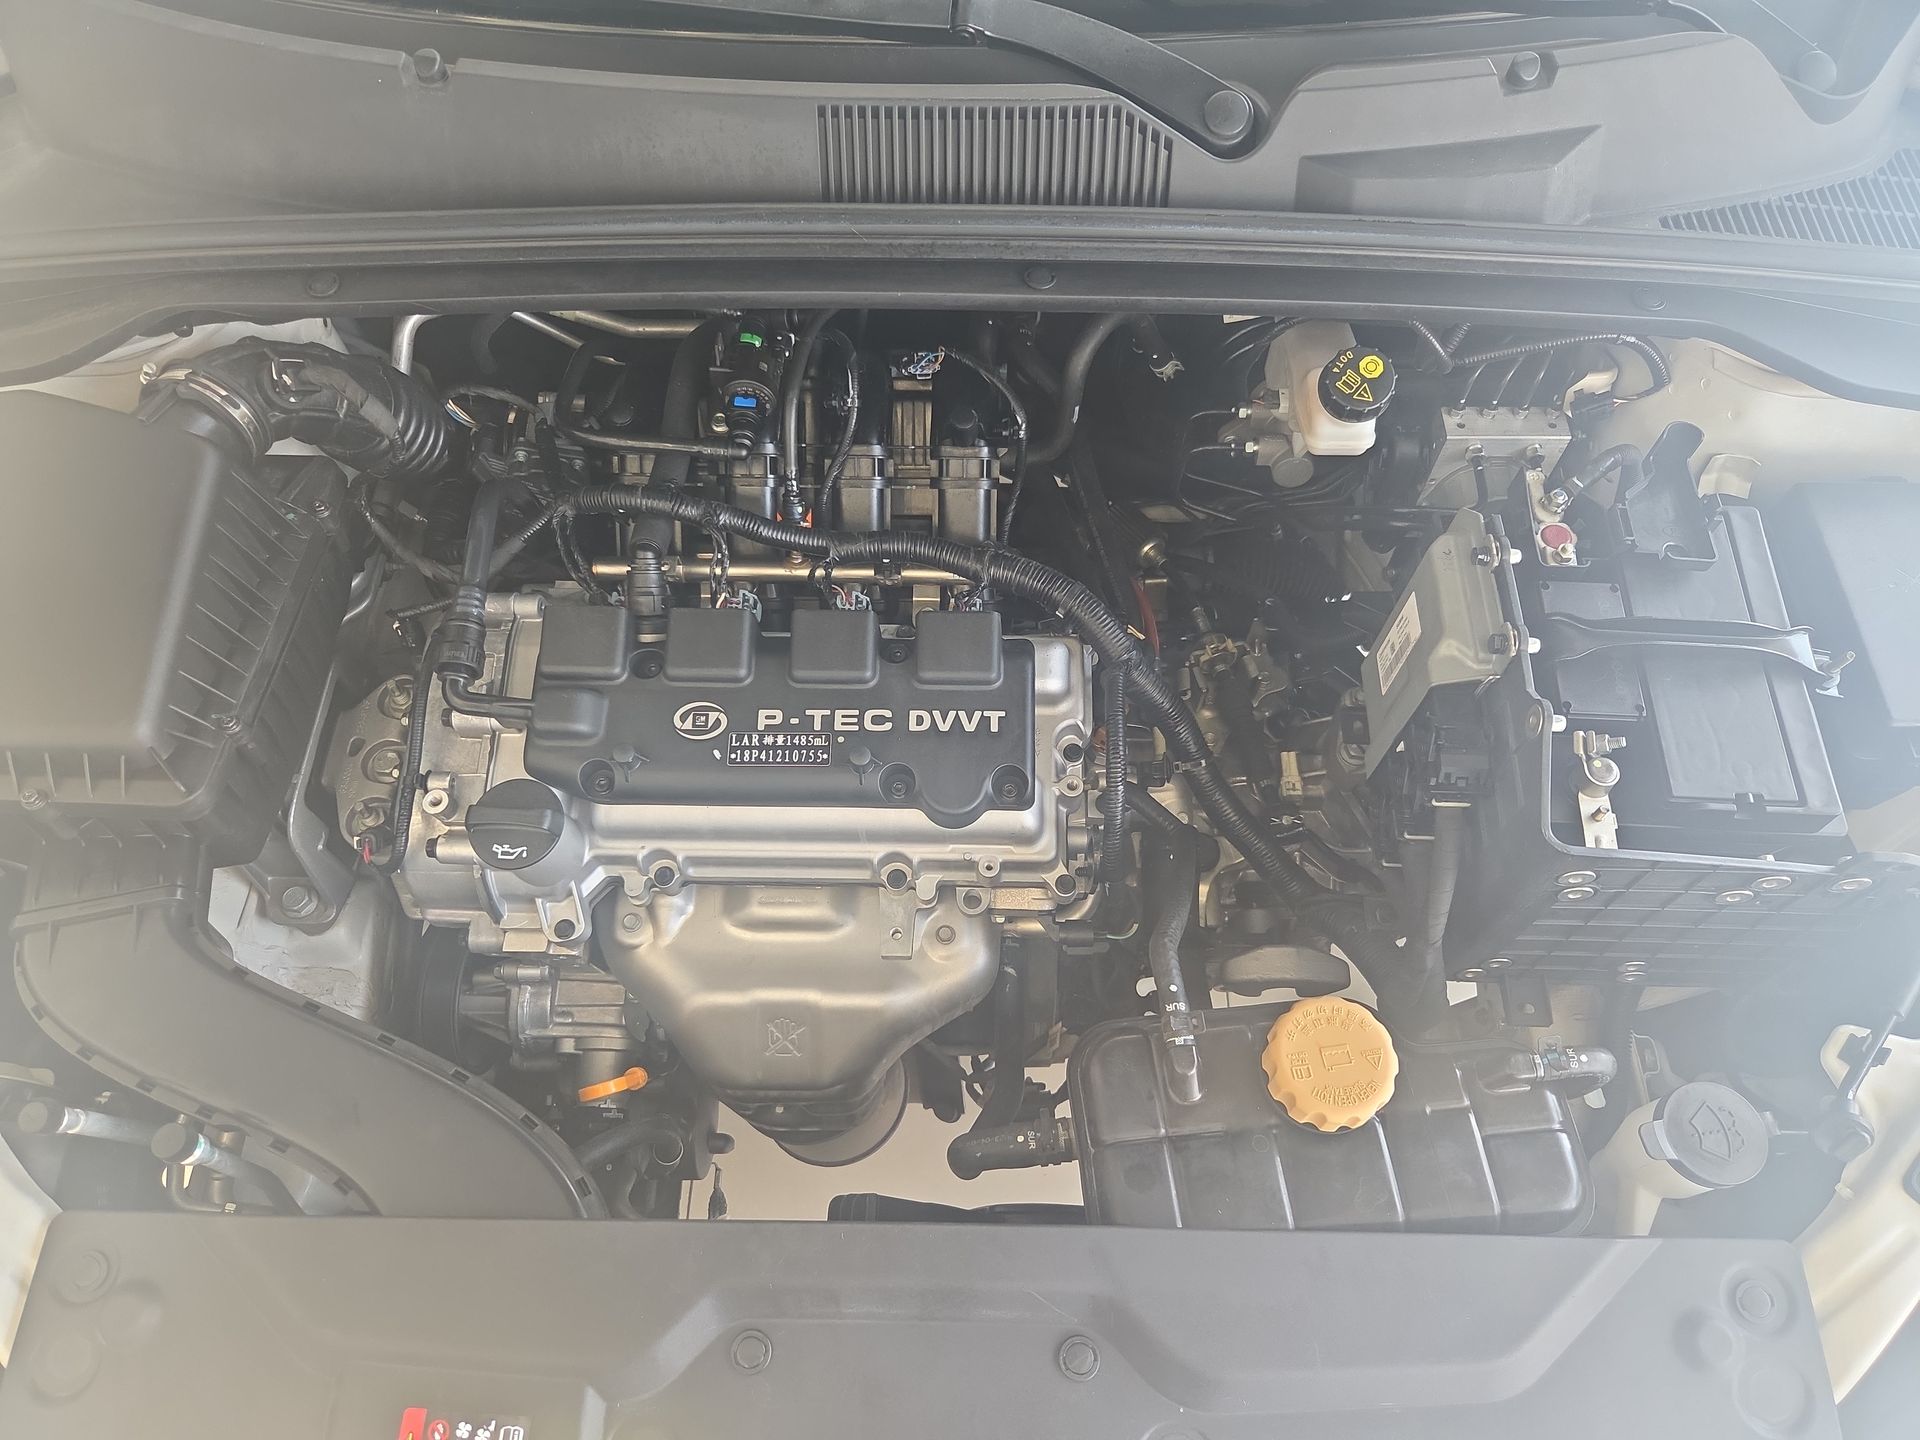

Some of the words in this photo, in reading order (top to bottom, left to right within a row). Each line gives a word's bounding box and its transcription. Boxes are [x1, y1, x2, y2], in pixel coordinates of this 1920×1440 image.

[1332, 350, 1354, 373] DOT4
[695, 715, 706, 724] GM
[757, 709, 893, 732] P-TEC
[908, 710, 1006, 733] DVVT
[731, 734, 760, 747] LAR
[1165, 1001, 1186, 1012] SUR
[1566, 1048, 1579, 1069] SUR
[1027, 1130, 1037, 1150] SUR
